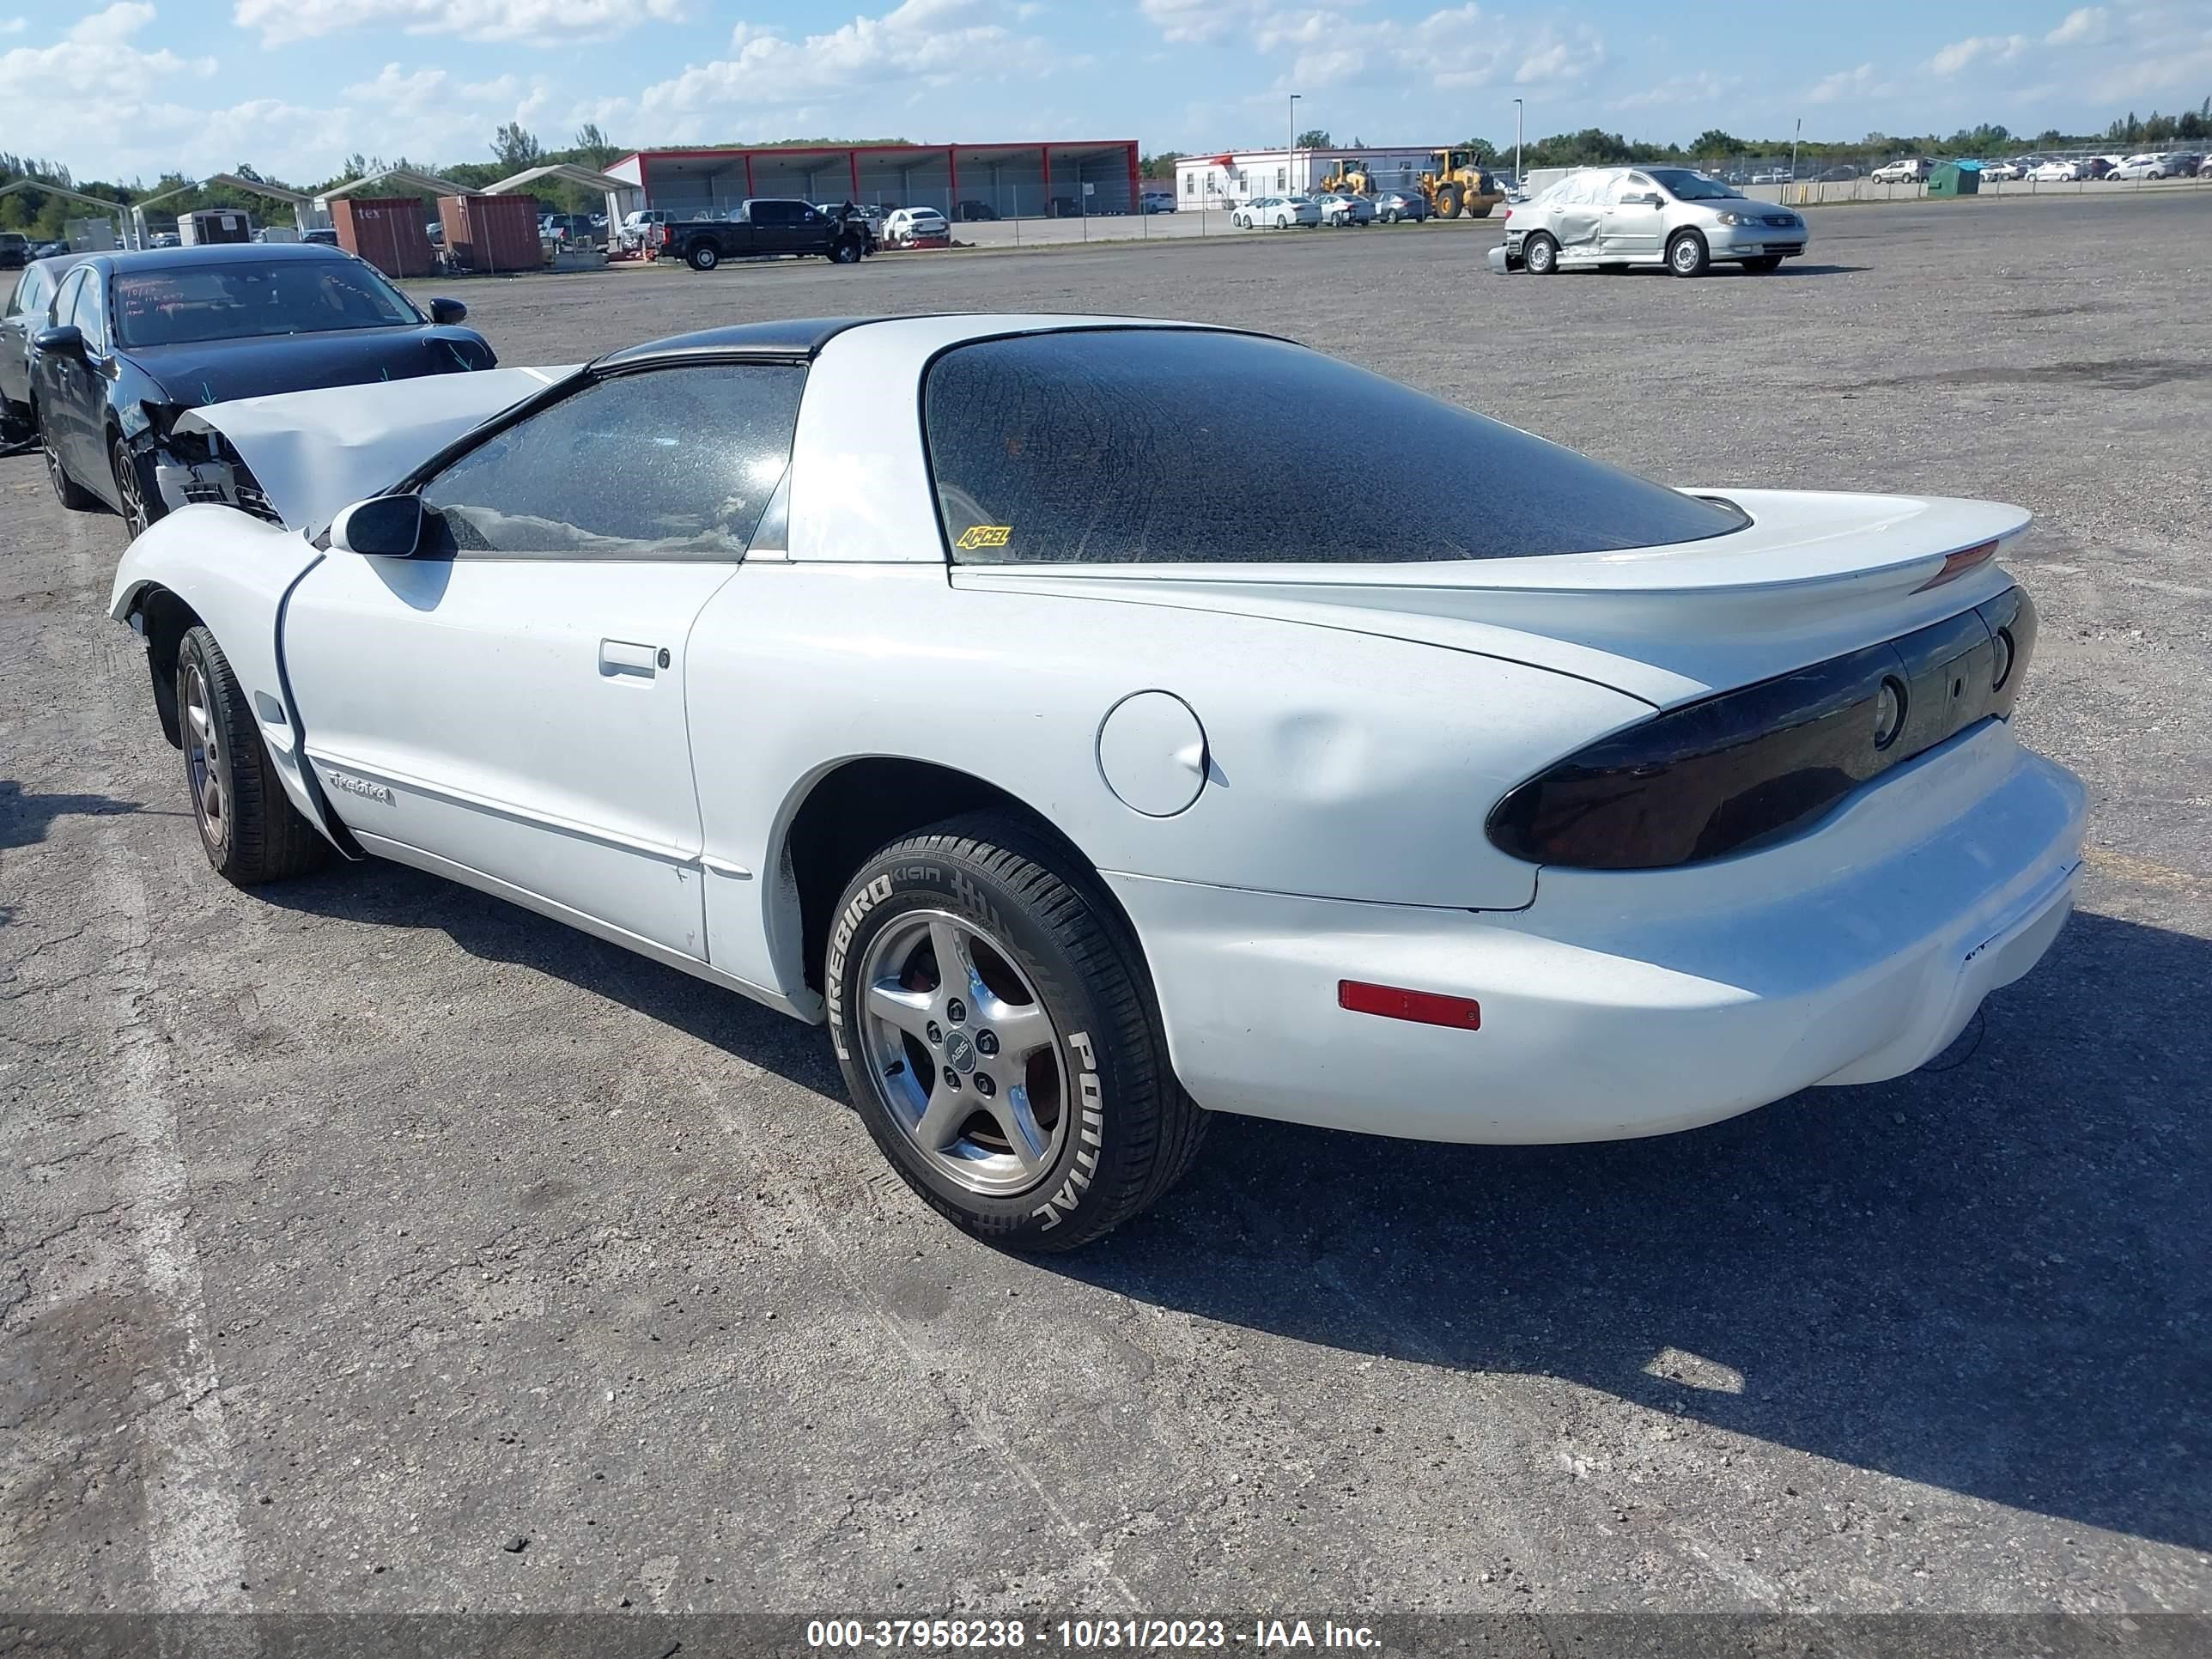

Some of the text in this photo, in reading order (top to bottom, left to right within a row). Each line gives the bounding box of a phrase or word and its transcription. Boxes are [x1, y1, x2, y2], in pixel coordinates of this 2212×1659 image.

[358, 208, 380, 220] tex
[957, 526, 1011, 549] ACCEL
[828, 873, 894, 1060] FIREBIRD
[951, 1040, 969, 1065] ABS
[1031, 1030, 1103, 1231] PONTIAC
